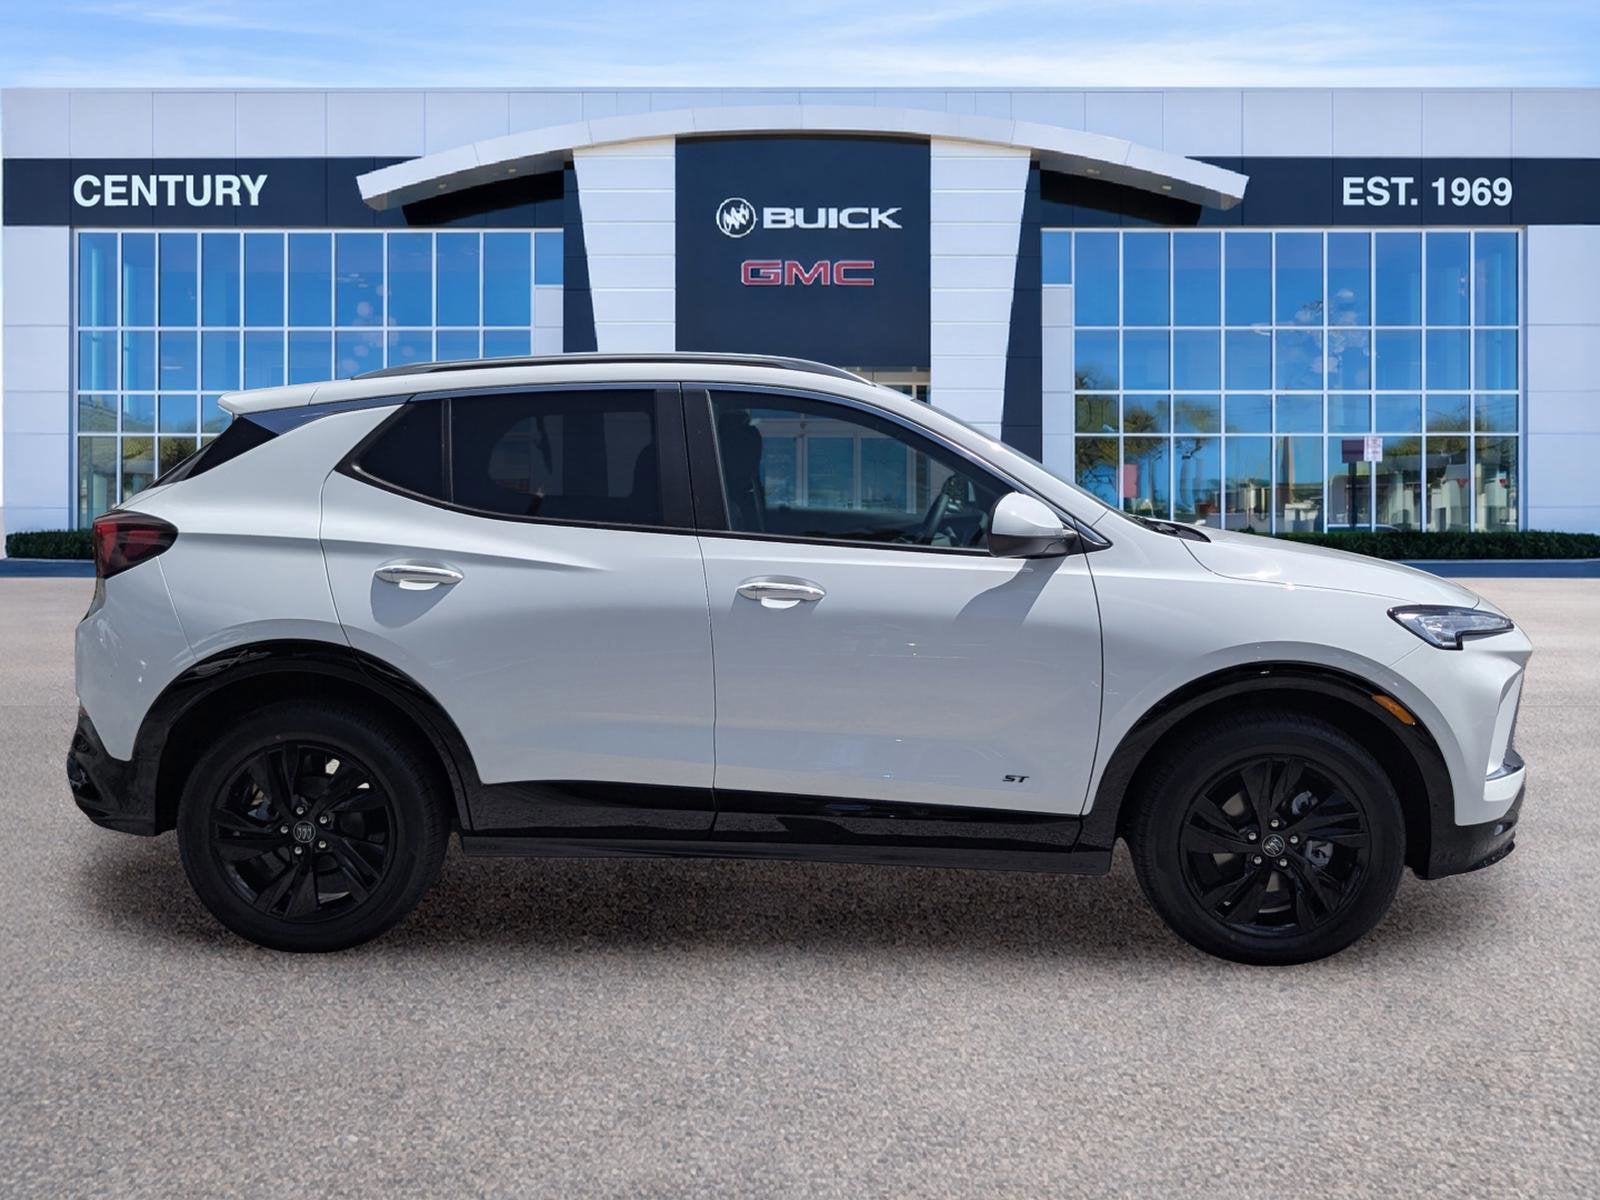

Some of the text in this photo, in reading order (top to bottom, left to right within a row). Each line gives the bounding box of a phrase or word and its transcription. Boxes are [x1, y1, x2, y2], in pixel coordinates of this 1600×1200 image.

[73, 173, 268, 207] CENTURY
[1342, 175, 1513, 206] EST. 1969
[762, 206, 903, 229] BUICK
[740, 260, 875, 286] GMC
[1002, 774, 1030, 783] ST
